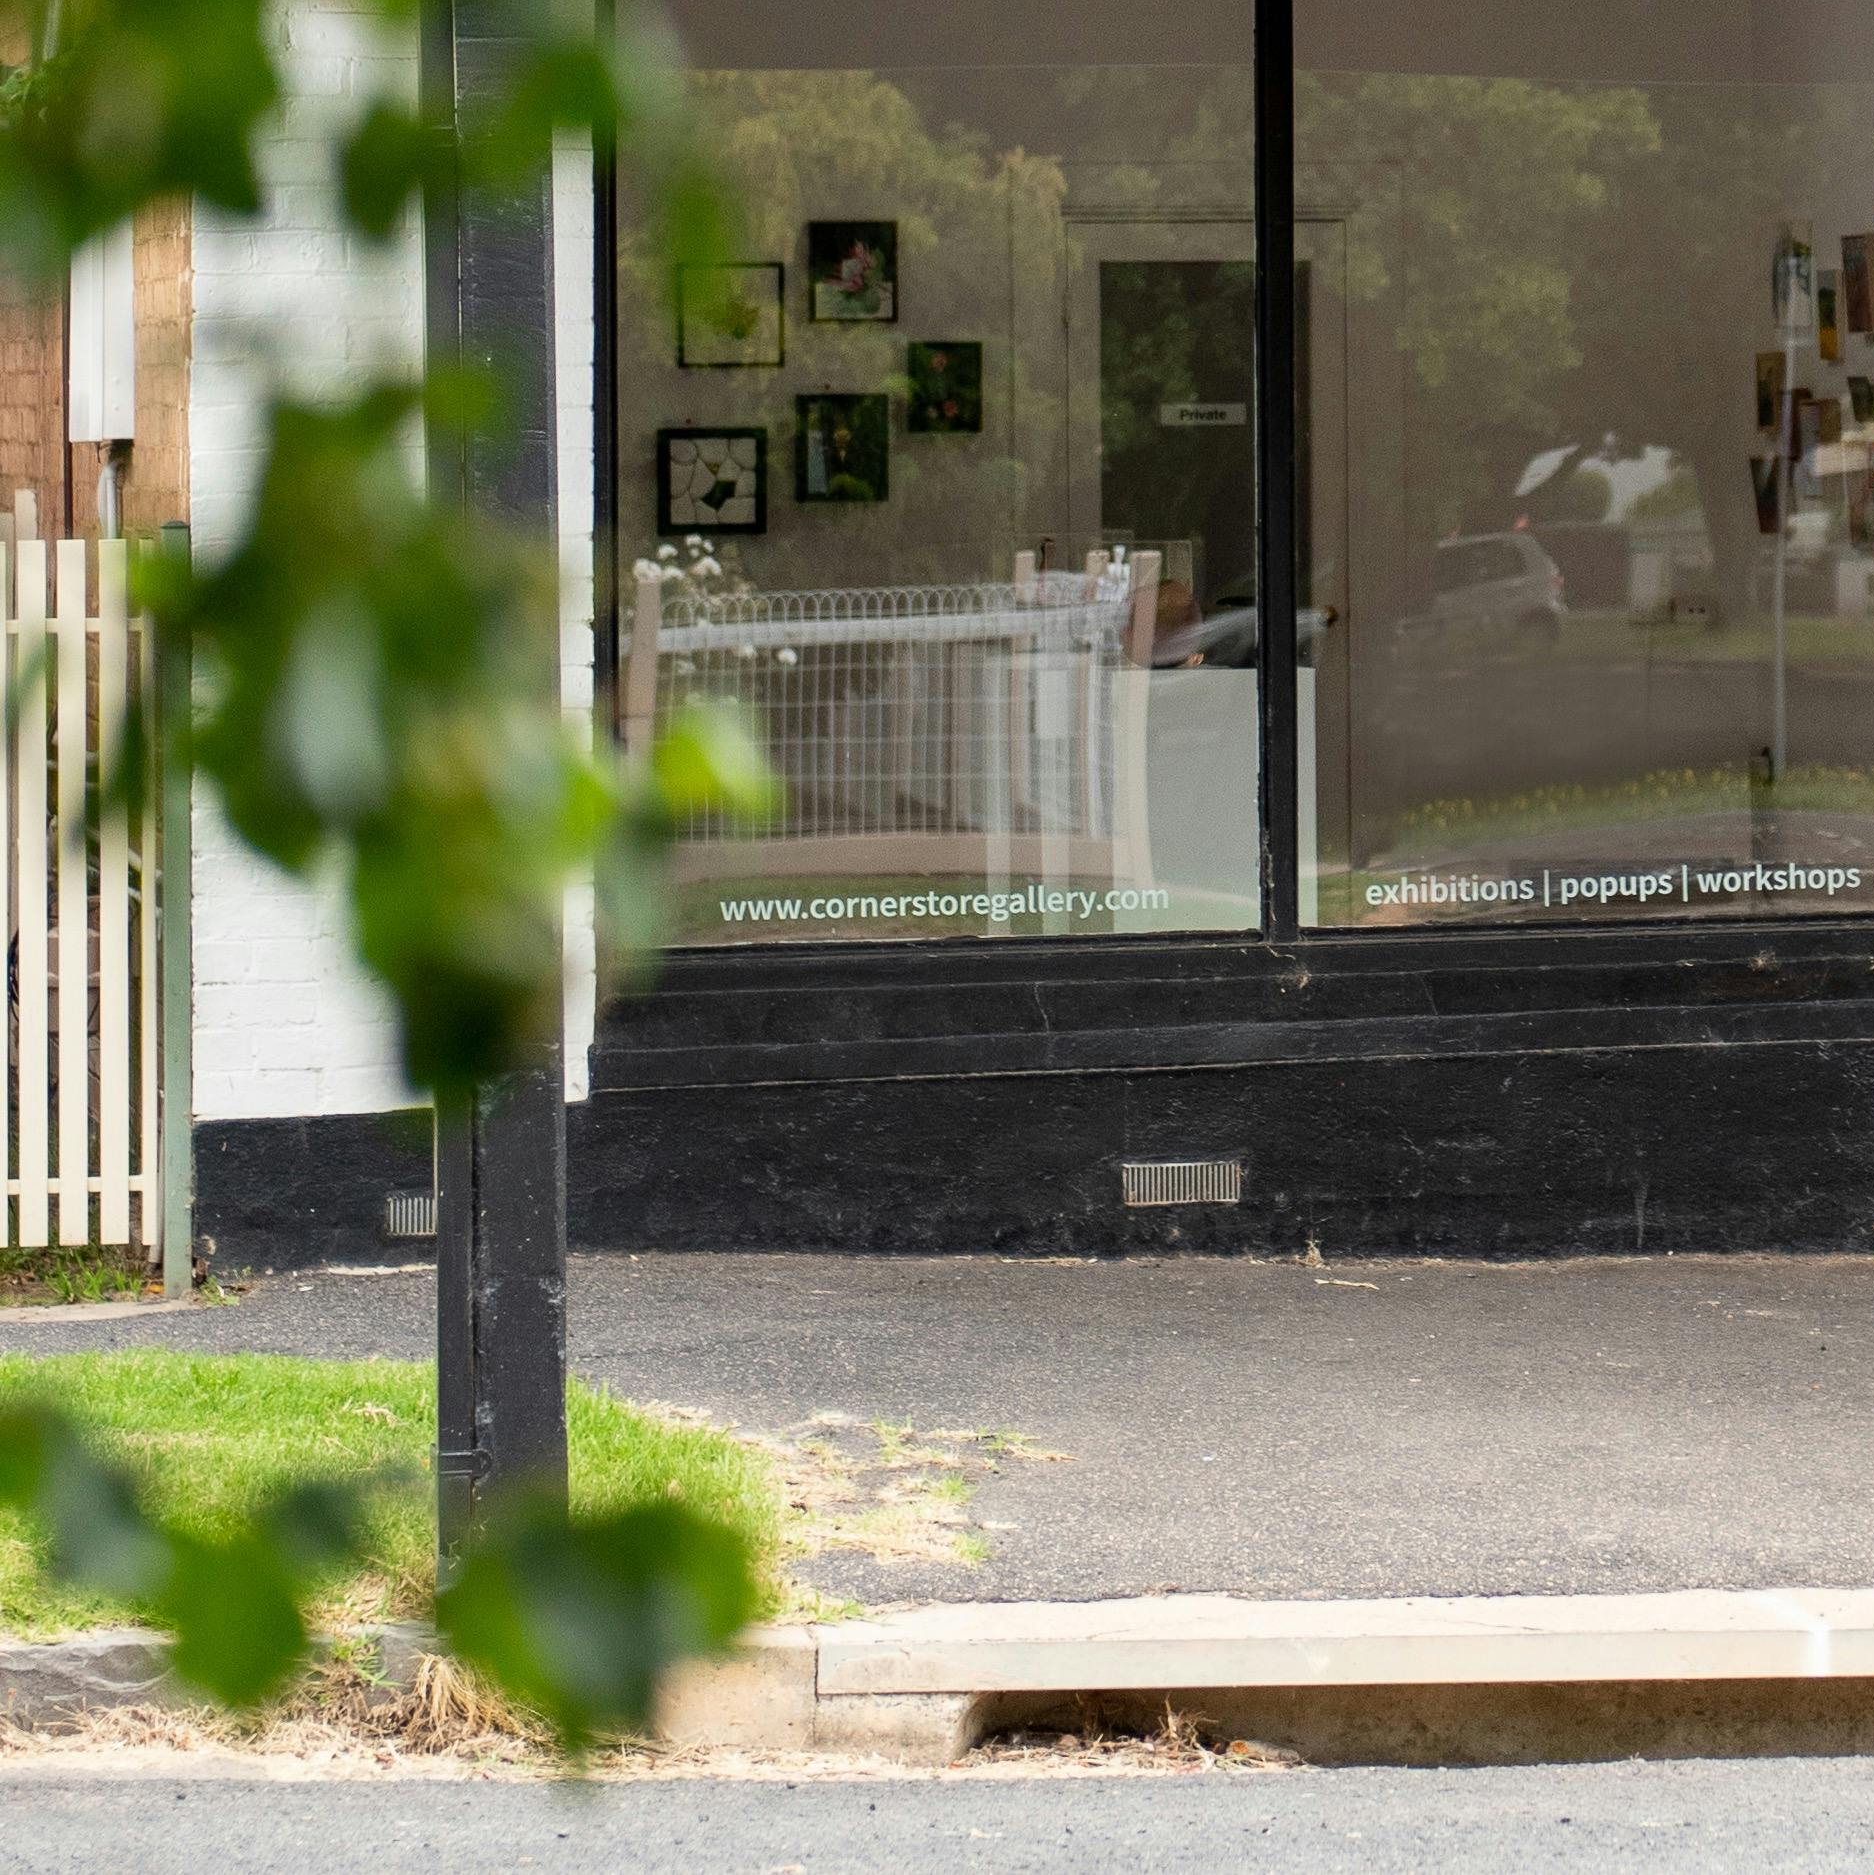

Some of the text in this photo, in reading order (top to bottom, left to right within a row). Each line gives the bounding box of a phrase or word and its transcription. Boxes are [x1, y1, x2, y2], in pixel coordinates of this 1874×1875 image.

[1180, 408, 1227, 421] Private
[719, 883, 1170, 923] www.cornerstoregallery.com
[1365, 863, 1862, 906] exhibitions popups workshops
